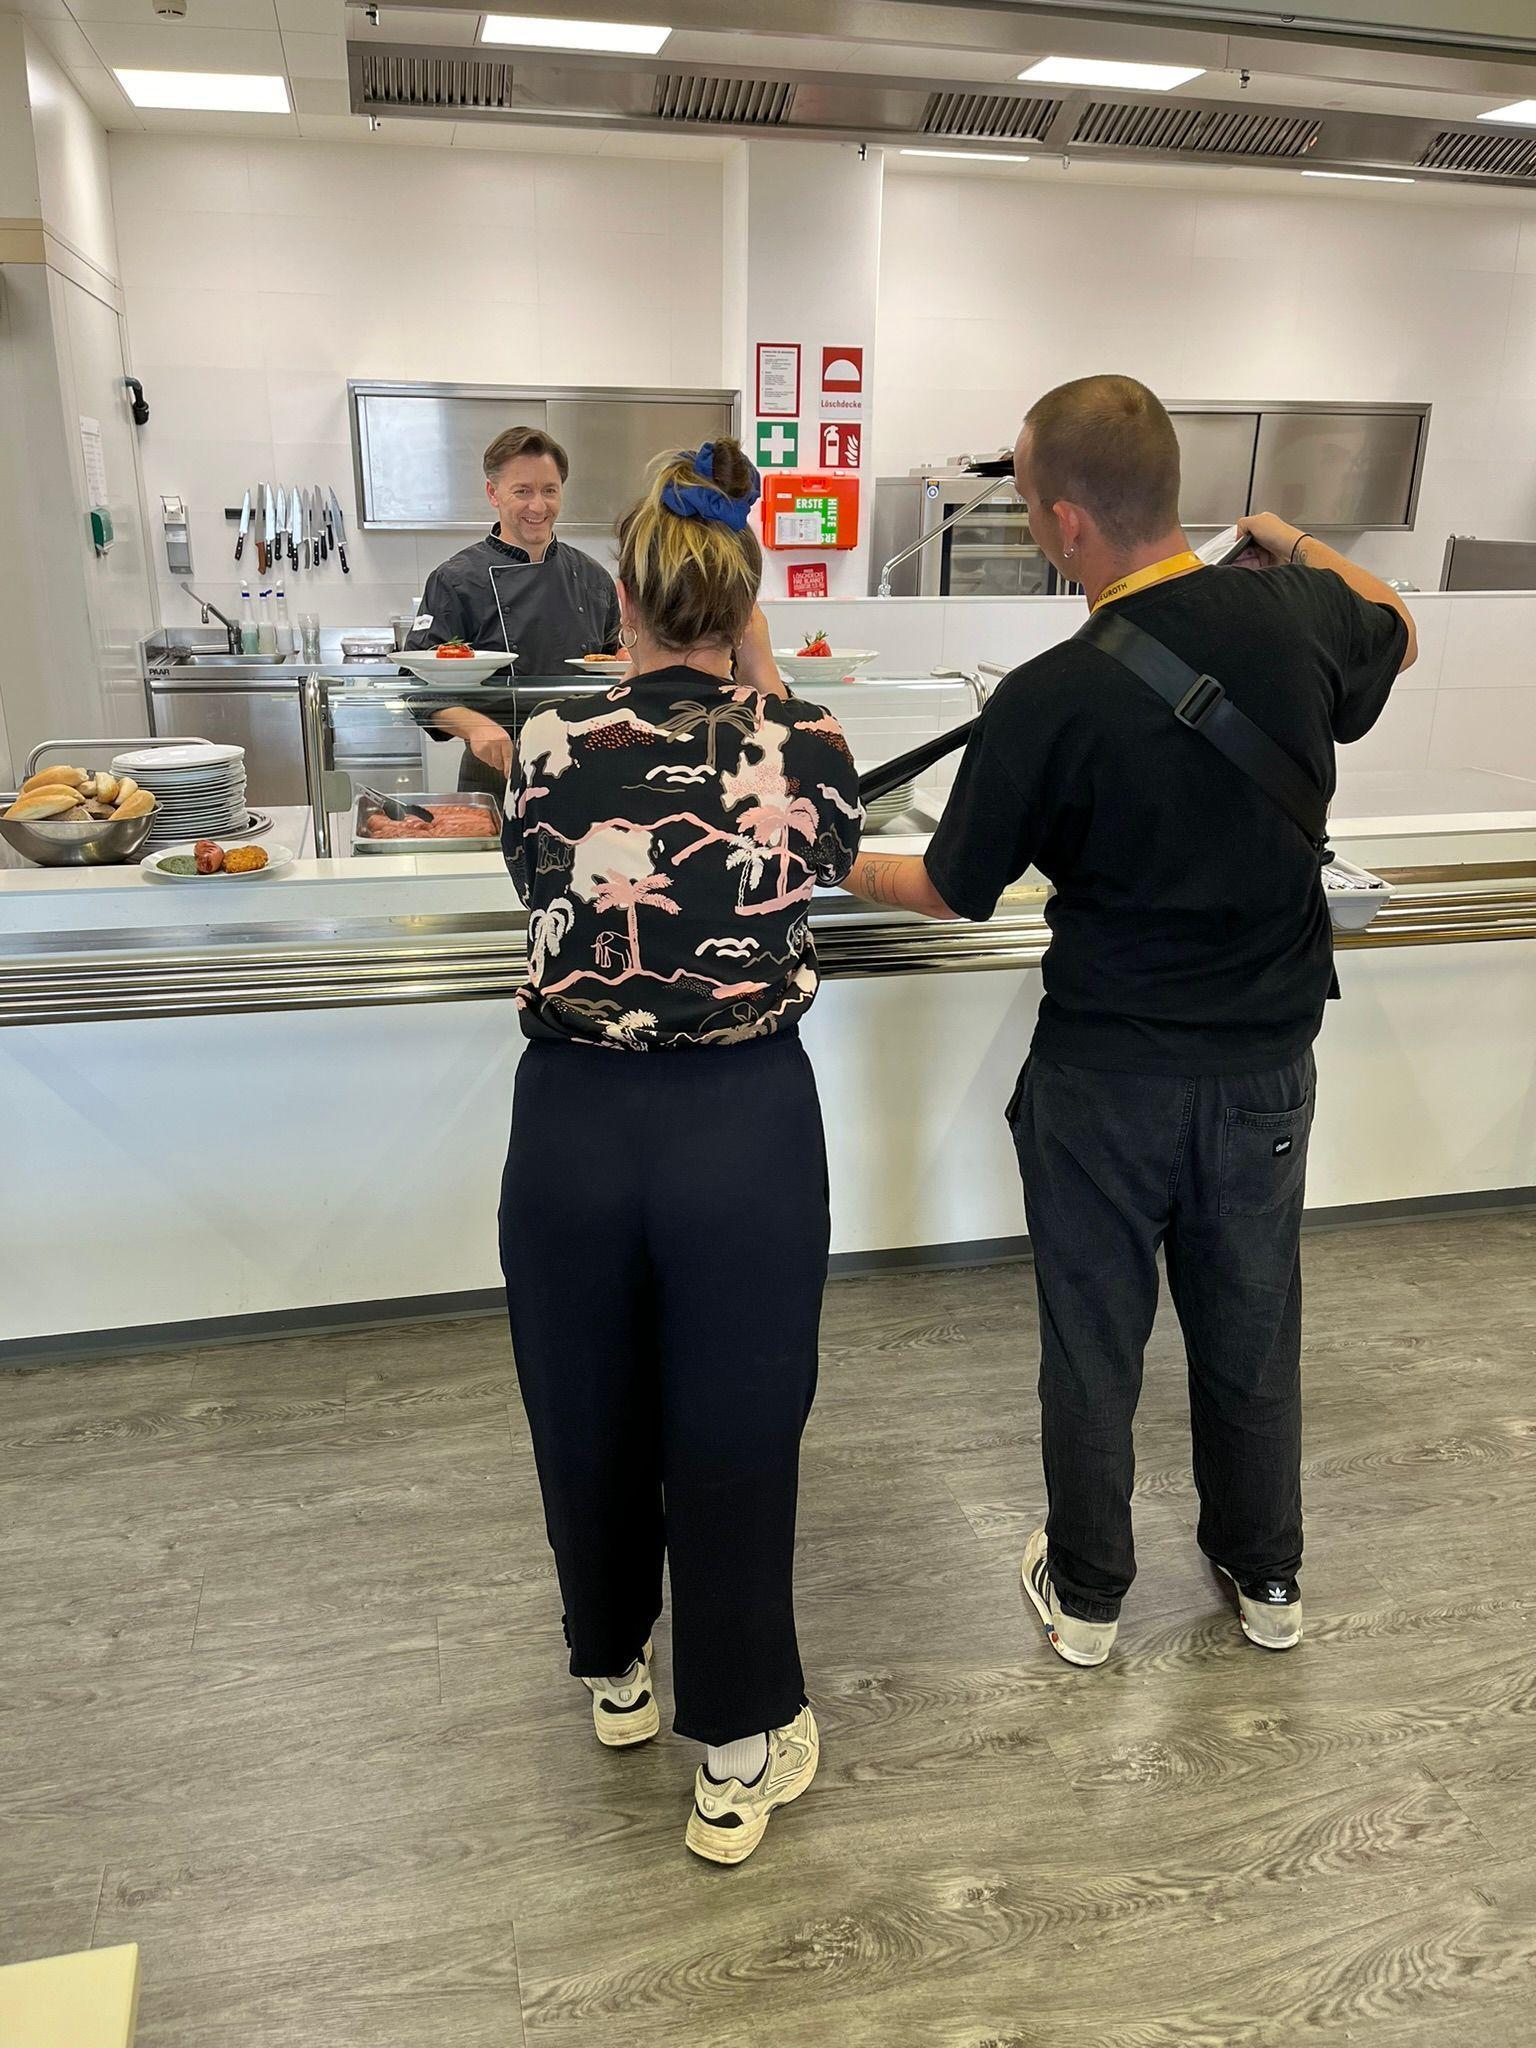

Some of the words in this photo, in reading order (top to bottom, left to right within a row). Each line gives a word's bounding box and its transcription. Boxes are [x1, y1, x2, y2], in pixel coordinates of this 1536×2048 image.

[821, 400, 862, 408] Löschdecke
[796, 498, 823, 509] ERSTE
[827, 498, 837, 528] HILFE
